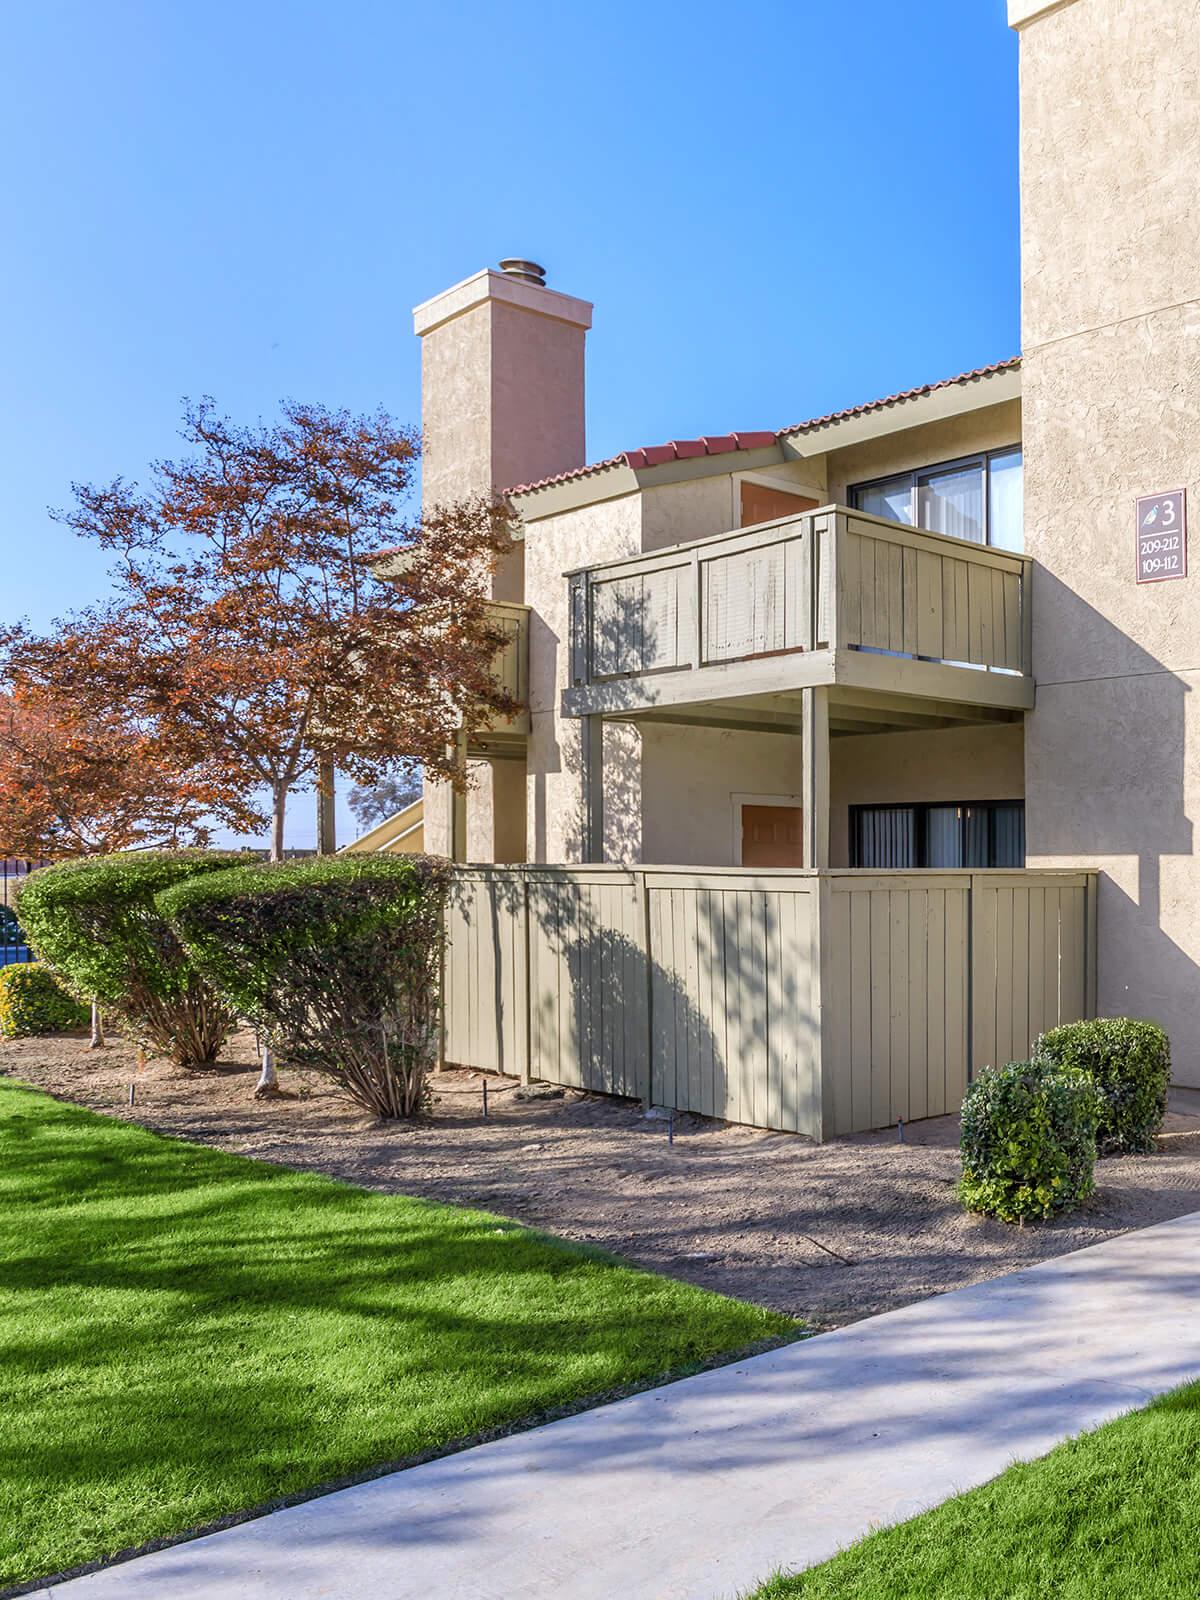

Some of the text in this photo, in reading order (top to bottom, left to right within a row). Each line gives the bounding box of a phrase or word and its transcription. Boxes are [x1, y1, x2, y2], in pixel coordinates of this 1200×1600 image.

[1162, 500, 1175, 526] 3
[1140, 536, 1180, 555] 209-212
[1142, 555, 1179, 574] 109-112
